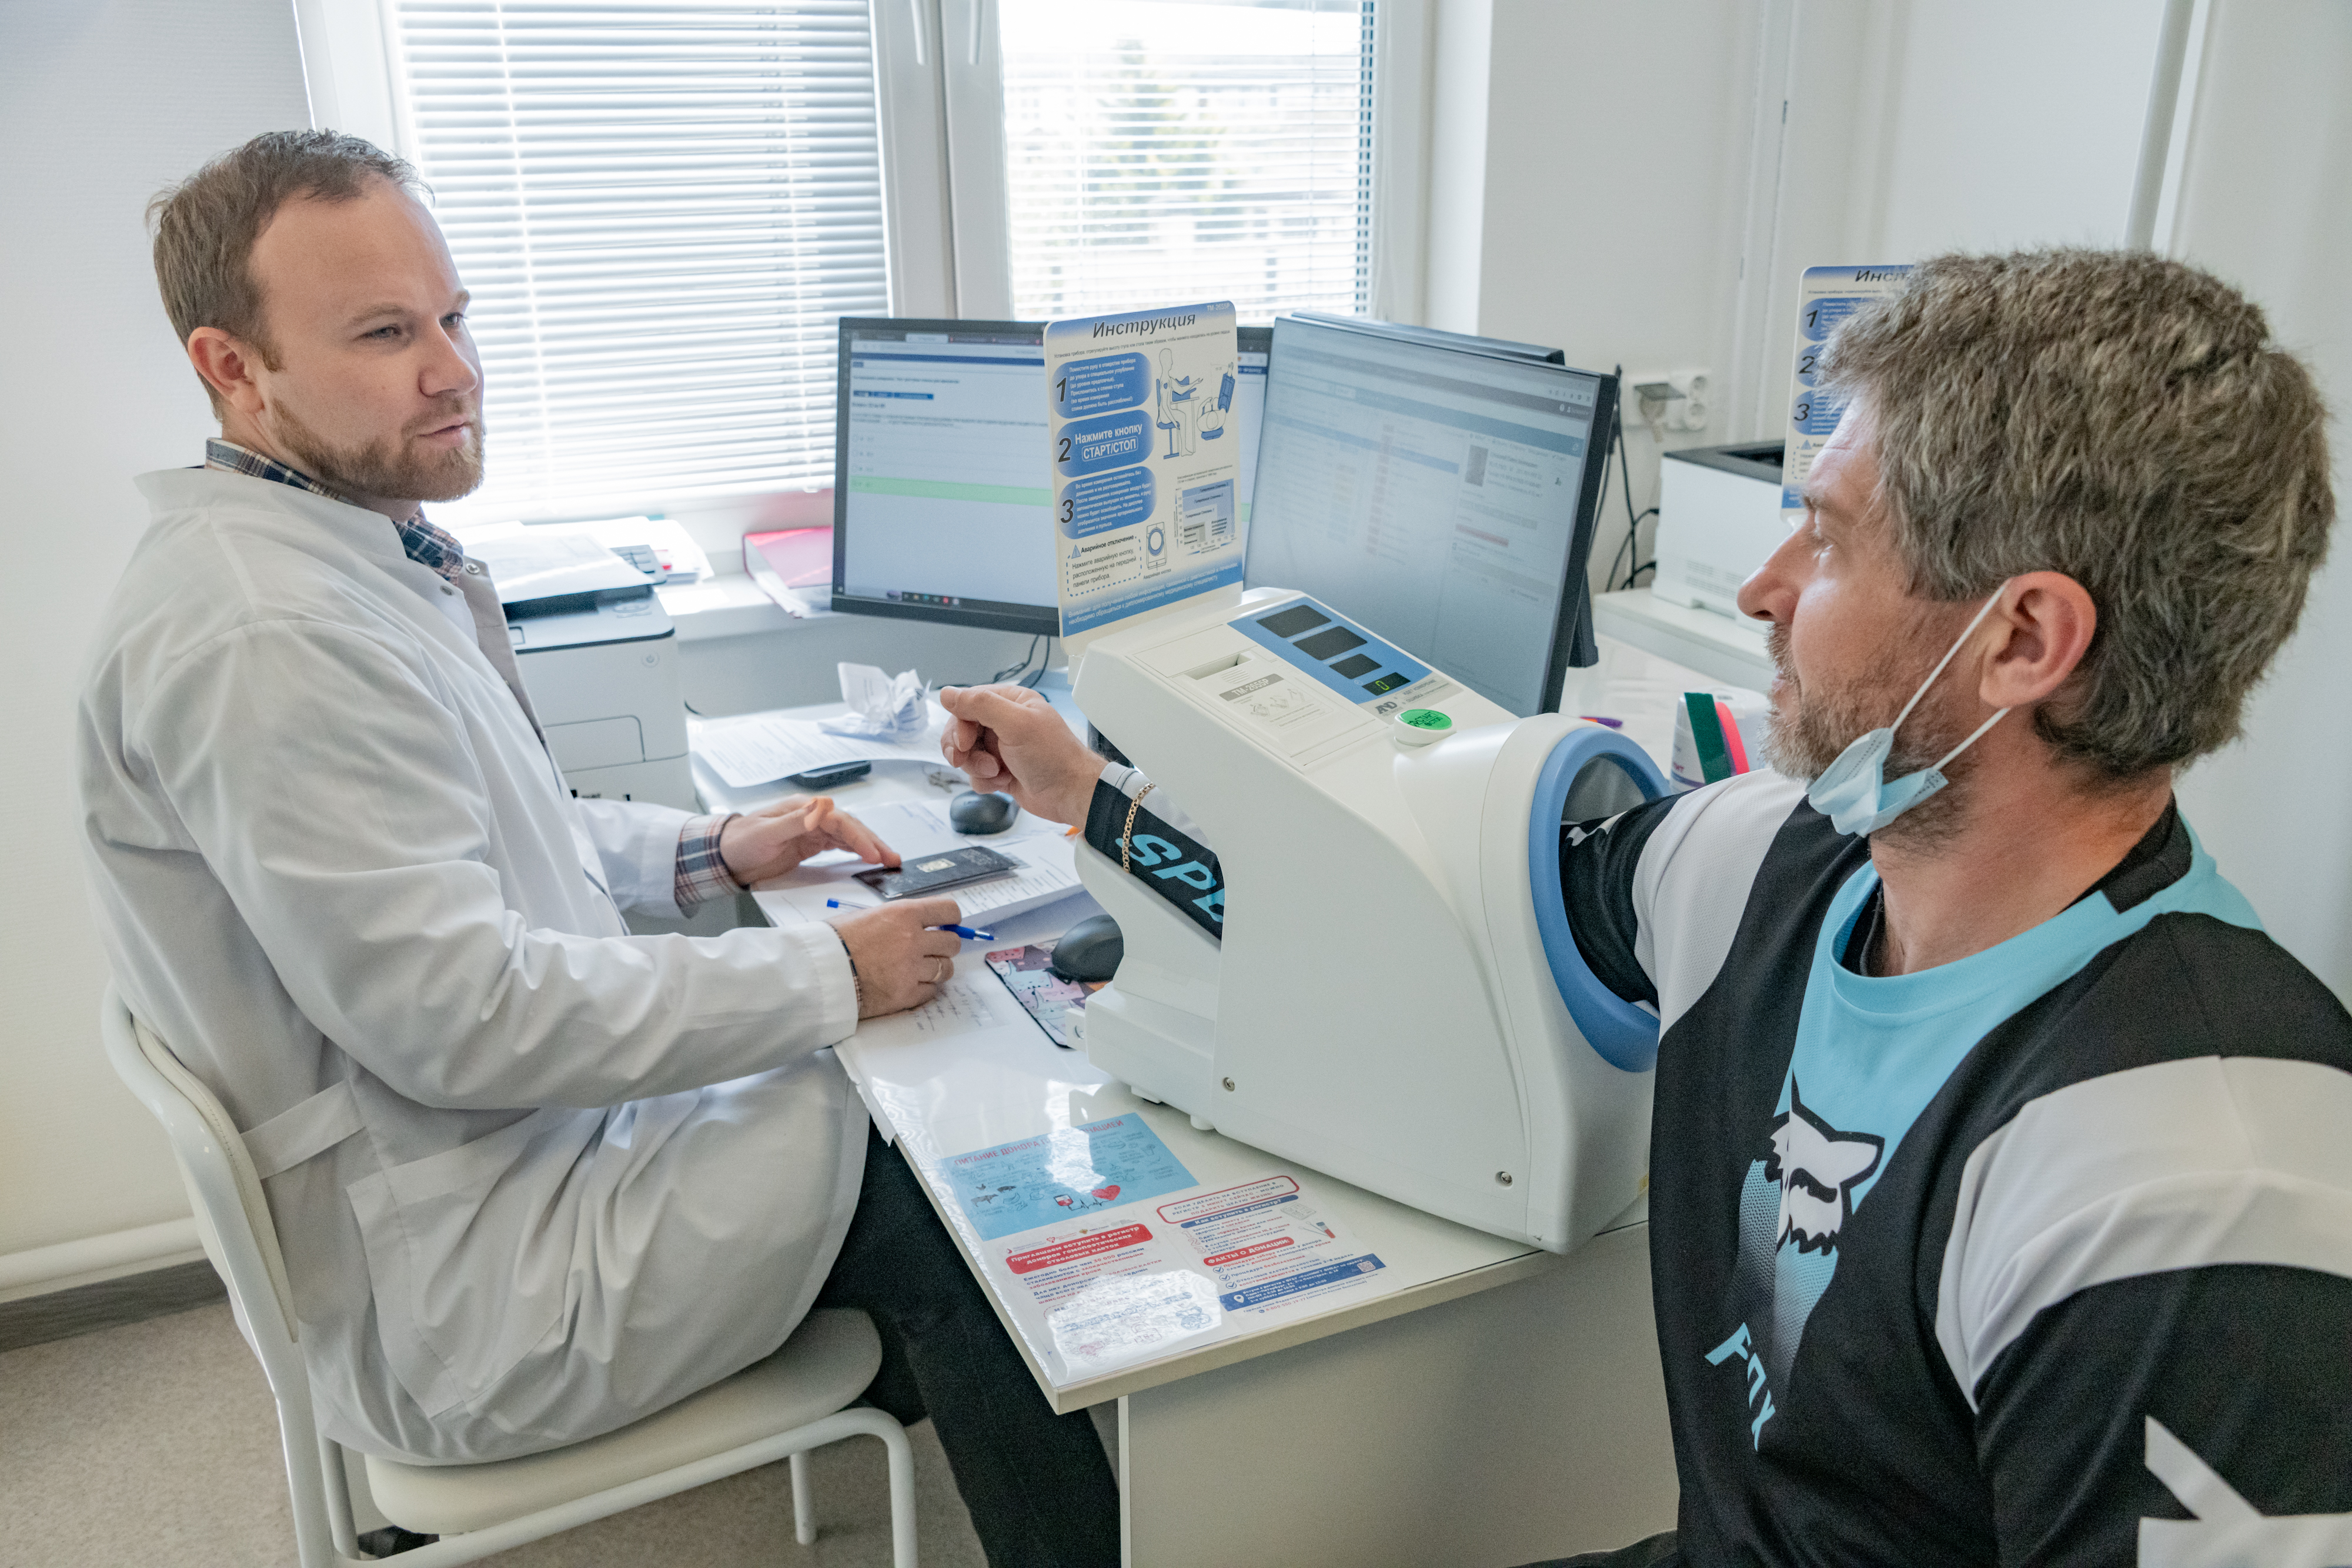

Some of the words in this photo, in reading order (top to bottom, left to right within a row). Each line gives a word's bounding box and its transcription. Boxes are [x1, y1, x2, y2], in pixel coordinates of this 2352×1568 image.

[1855, 270, 1910, 282] Инст
[1093, 314, 1195, 338] Инструкция
[1806, 310, 1819, 328] 1
[1799, 356, 1815, 374] 2
[1056, 377, 1066, 402] 1
[1794, 403, 1810, 422] 3
[1075, 429, 1112, 444] Нажмите
[1114, 424, 1142, 436] кнопку
[1058, 437, 1071, 462] 2
[1083, 438, 1135, 459] СТАРТ/СТОП
[1060, 499, 1074, 523] 3
[1081, 542, 1106, 553] Аварийное
[1107, 535, 1134, 546] отключение
[1072, 560, 1093, 569] Нажмите
[1094, 553, 1118, 563] аварийную
[1073, 564, 1108, 580] расположенную
[1115, 557, 1136, 566] передней
[1073, 579, 1089, 587] панели
[1090, 573, 1110, 583] прибора.
[1231, 678, 1269, 696] TM-2655P
[1375, 680, 1390, 691] 0
[1415, 711, 1437, 723] СТАРТ
[1429, 717, 1444, 726] СТОП
[954, 1150, 998, 1165] ПИТАНИЕ
[1000, 1141, 1040, 1155] ДОНОРА
[1191, 1205, 1224, 1215] ПОДАРИТЬ
[1210, 1210, 1242, 1220] вступить
[1250, 1199, 1284, 1211] регистр?
[1011, 1246, 1061, 1262] Приглашаем
[1063, 1237, 1099, 1248] вступить
[1107, 1226, 1139, 1238] регистр
[1027, 1252, 1061, 1264] доноров
[1063, 1233, 1132, 1254] гемопоэтических
[1046, 1251, 1090, 1264] стволовых
[1091, 1243, 1119, 1252] клеток
[1208, 1252, 1238, 1263] ФАКТЫ
[1248, 1239, 1287, 1253] ДОНАЦИИ:
[1023, 1271, 1057, 1281] Ежегодно
[1117, 1247, 1144, 1257] россиян
[1102, 1265, 1137, 1277] тволовые
